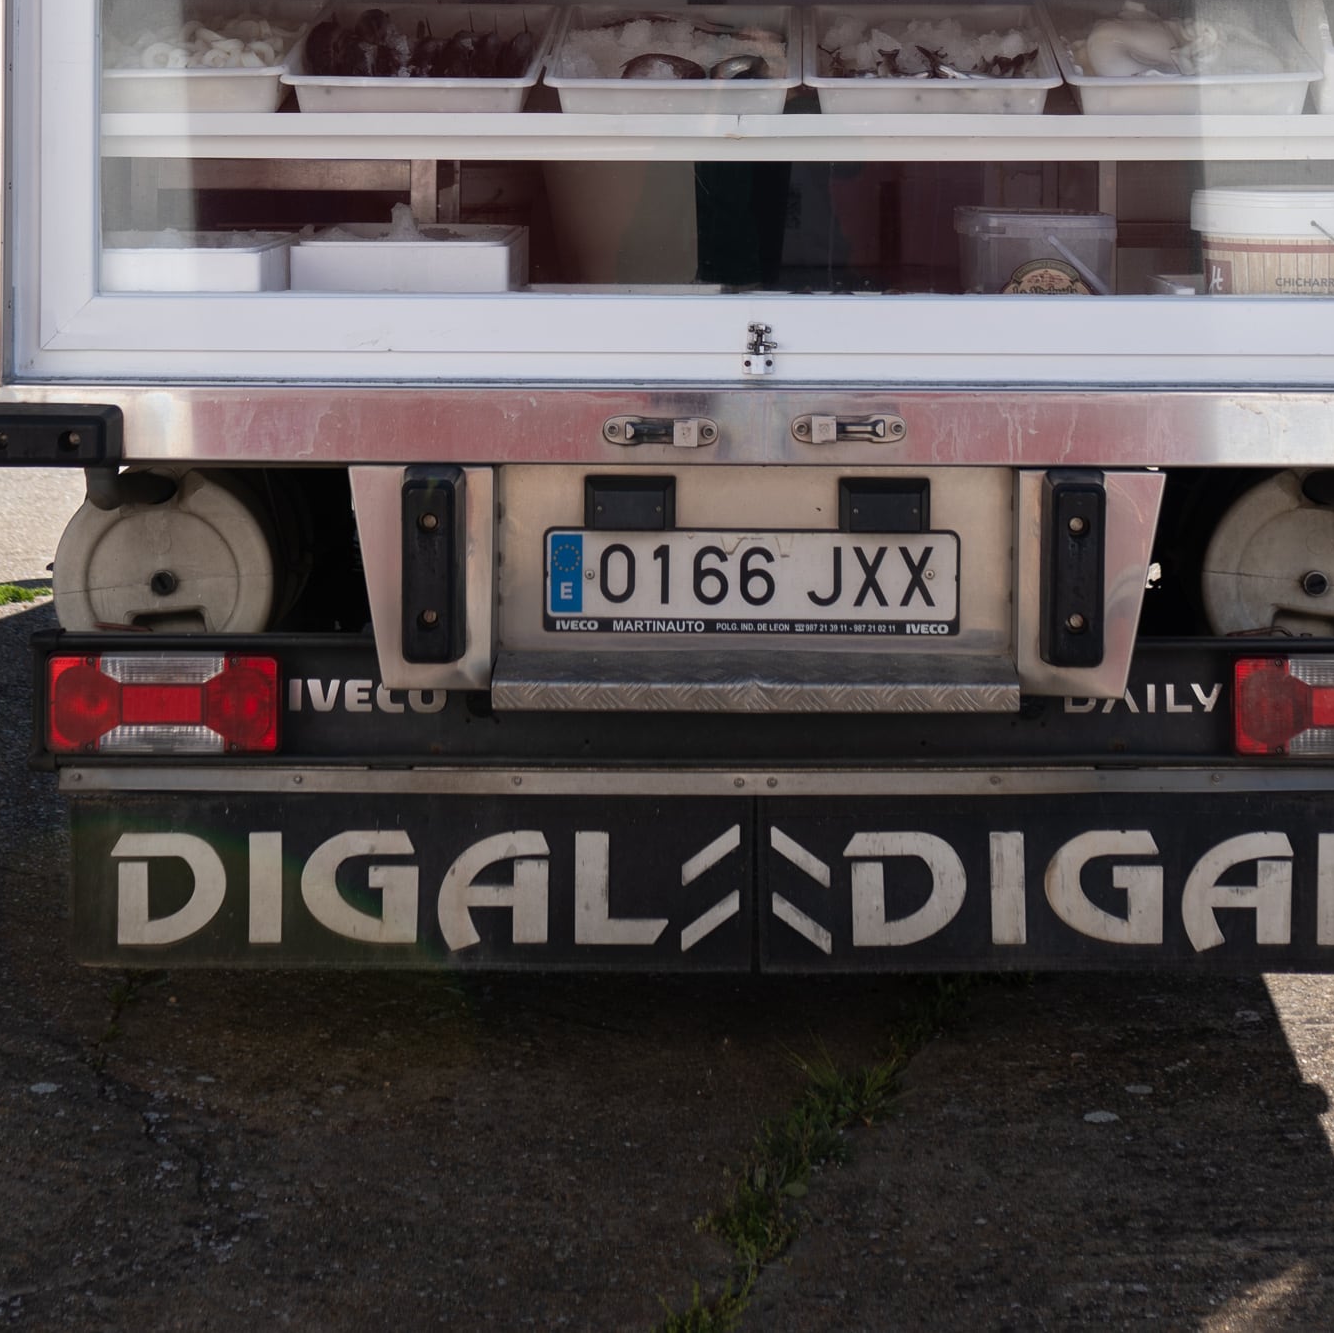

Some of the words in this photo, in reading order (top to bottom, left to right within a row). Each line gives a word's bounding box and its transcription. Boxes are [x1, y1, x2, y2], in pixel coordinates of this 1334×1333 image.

[560, 581, 573, 600] E
[599, 543, 776, 606] 0166
[806, 545, 936, 607] JXX
[555, 619, 598, 631] IVECO
[612, 619, 705, 633] MARTINAUTO
[740, 623, 756, 632] IND.
[757, 623, 768, 632] DE
[769, 623, 790, 632] LEON
[906, 624, 949, 634] IVECO
[289, 678, 448, 713] IVECO
[111, 830, 668, 951] DIGAL
